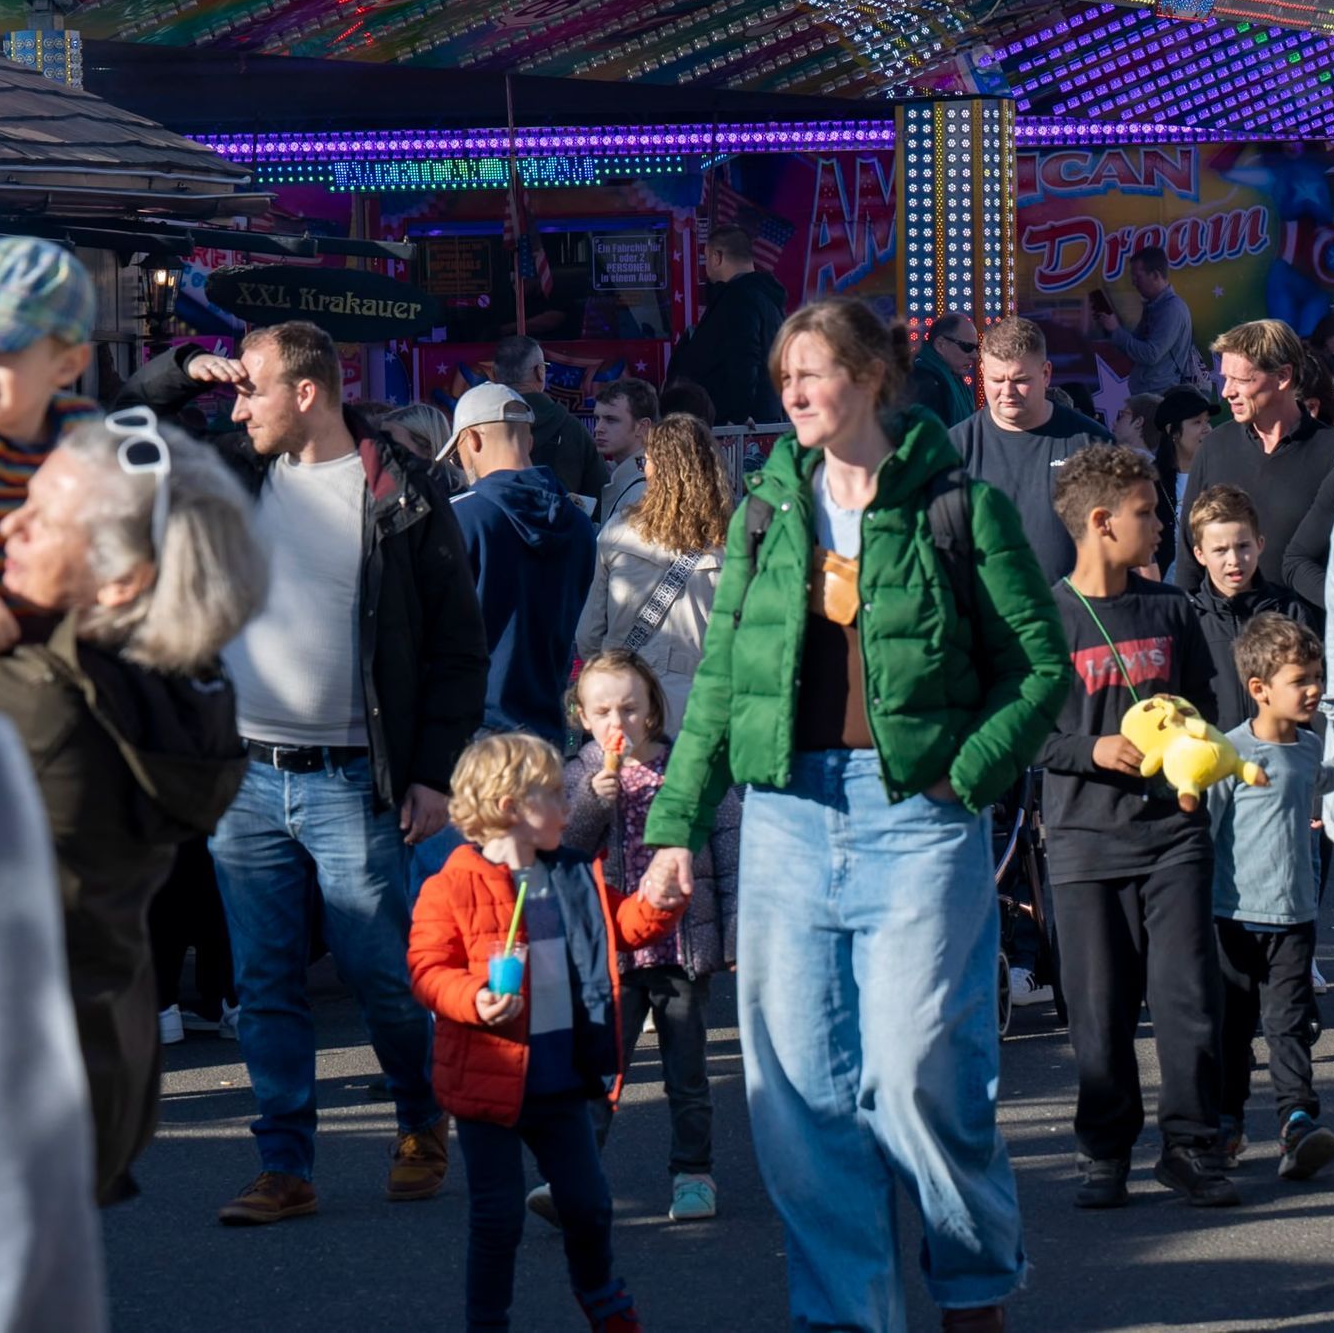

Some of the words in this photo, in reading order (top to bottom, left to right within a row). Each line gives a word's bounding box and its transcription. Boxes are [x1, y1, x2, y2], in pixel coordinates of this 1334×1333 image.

[1022, 206, 1269, 294] Dream
[606, 263, 651, 273] PERSONEN
[638, 272, 658, 283] Auto
[235, 282, 292, 309] XXL
[298, 286, 423, 321] Krakauer
